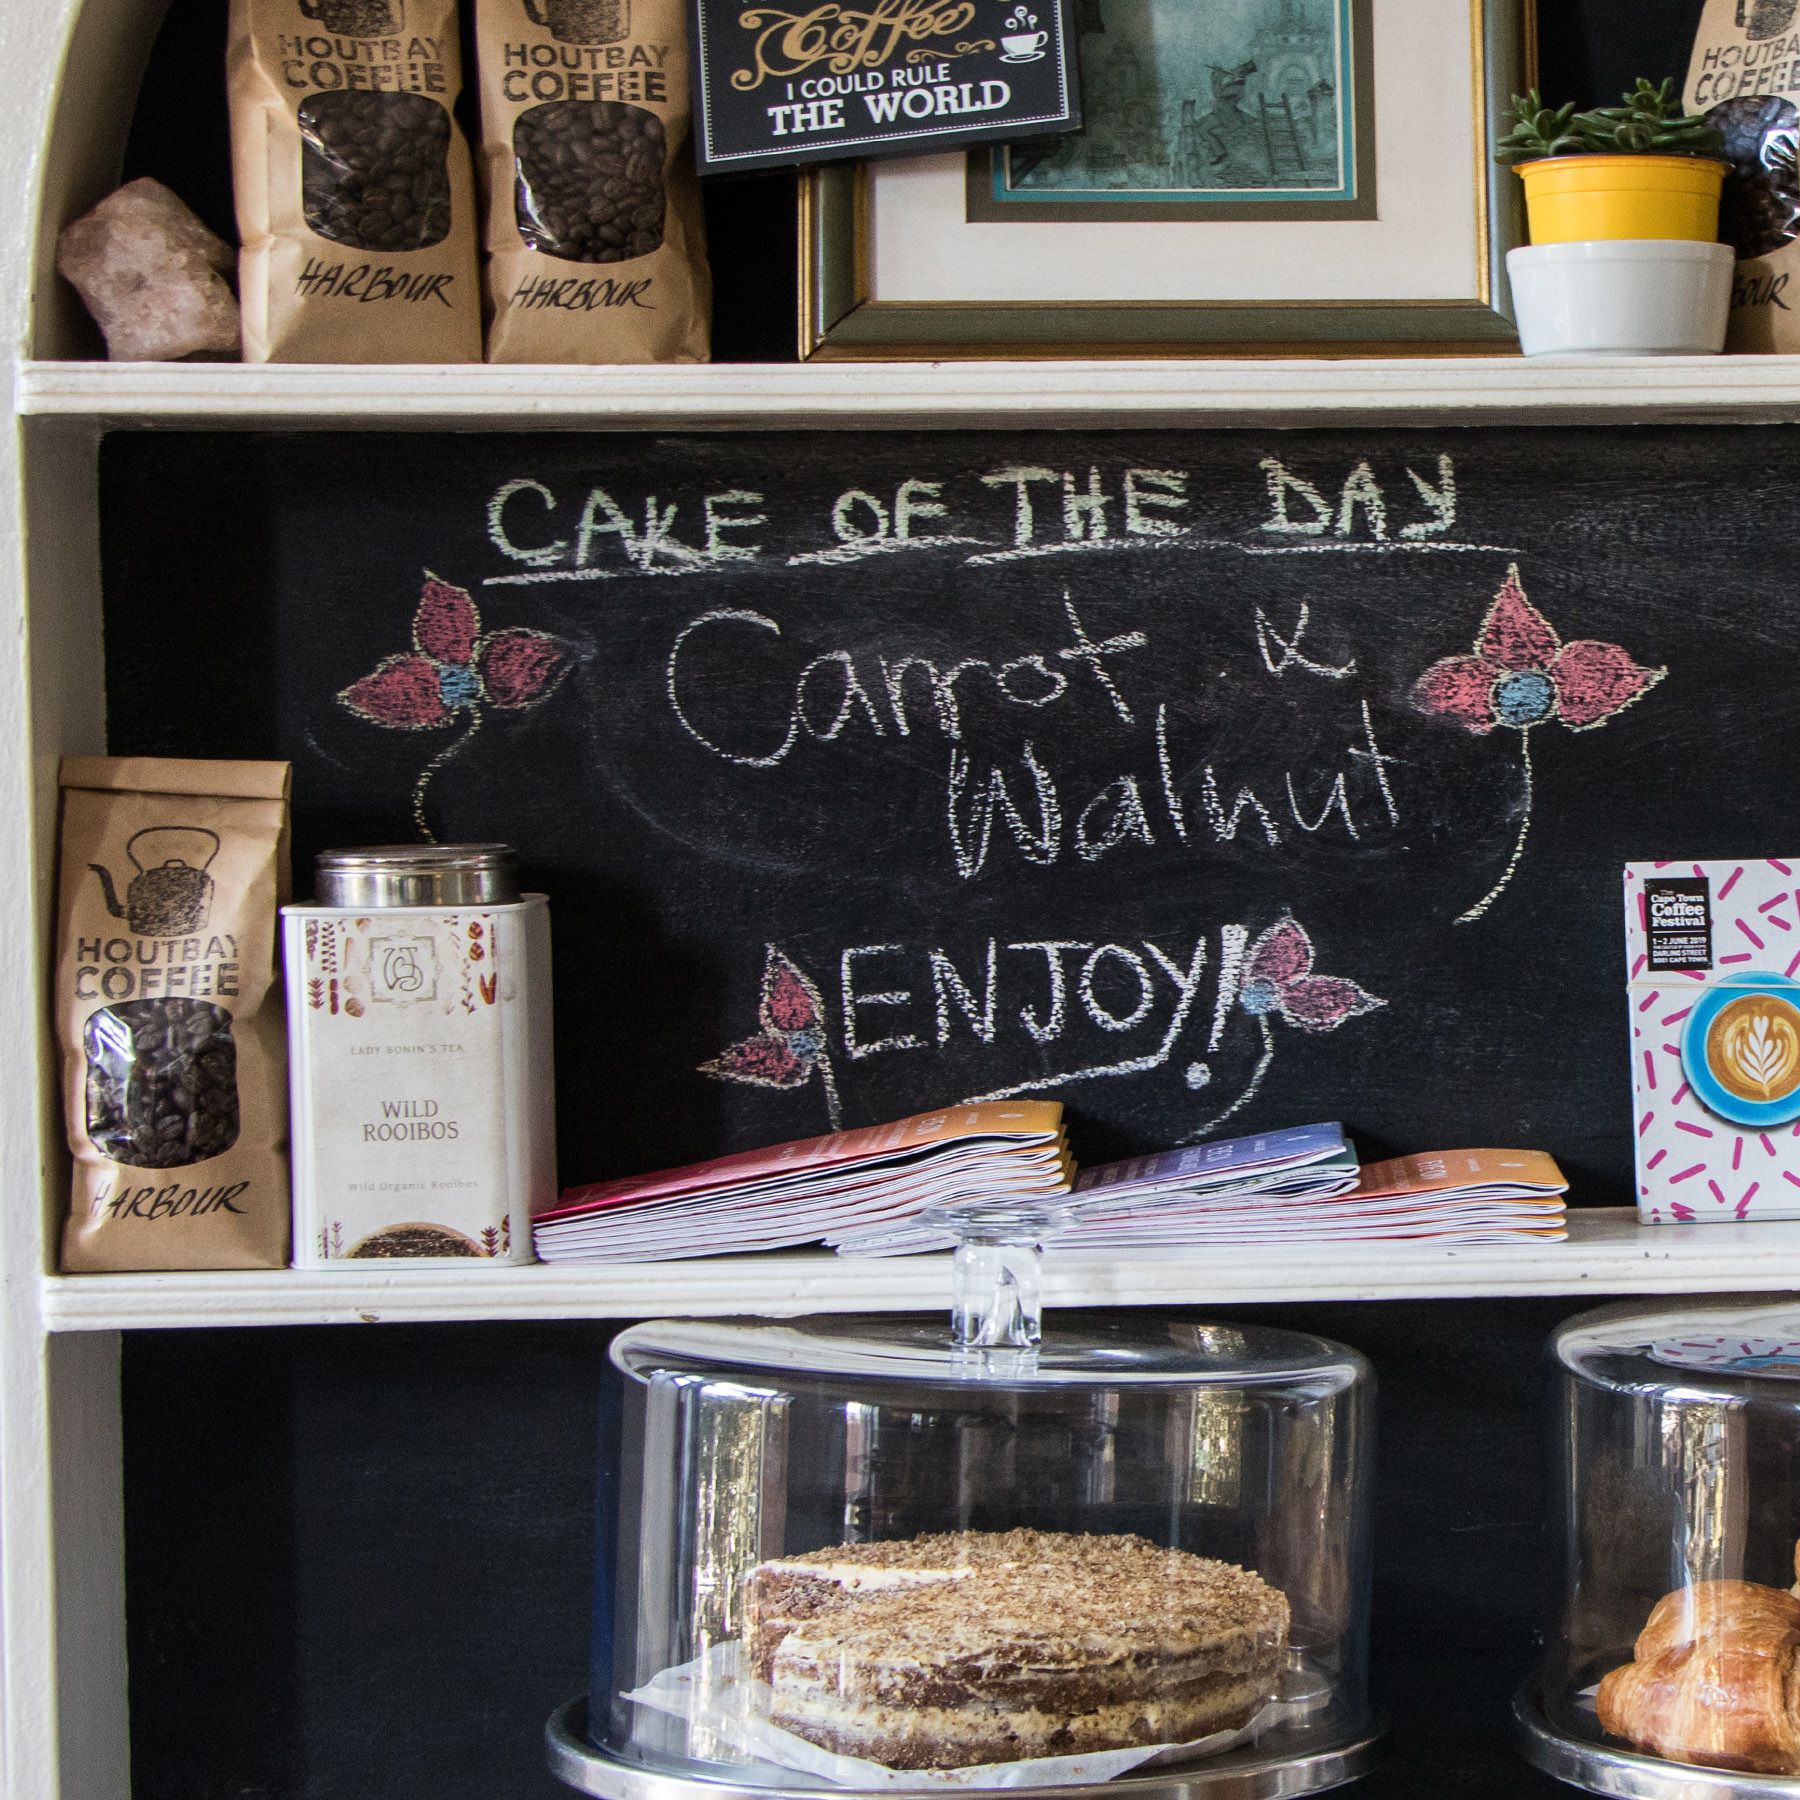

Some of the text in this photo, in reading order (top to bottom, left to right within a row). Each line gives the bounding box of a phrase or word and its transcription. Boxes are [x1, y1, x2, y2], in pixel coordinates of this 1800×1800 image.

[279, 34, 445, 62] HOUTBAY
[504, 43, 670, 70] HOUTBAY
[731, 0, 976, 90] Coffee
[283, 60, 448, 93] COFFEE
[503, 70, 668, 103] COFFEE
[786, 63, 951, 100] I COULD RULE
[767, 80, 1011, 136] THE WORLD
[297, 256, 454, 308] HARBOUR
[509, 275, 658, 310] HARBOUR
[485, 452, 1457, 572] CAKE OF THE DAY
[668, 590, 1148, 768] Carrot
[949, 699, 1402, 880] Walnut
[1651, 895, 1676, 903] Cape
[1651, 903, 1705, 916] Coffee
[1652, 917, 1705, 926] Festival
[77, 935, 239, 965] HOUTBAY
[75, 963, 240, 1001] COFFEE
[841, 923, 1250, 1100] ENJOY!
[350, 1046, 381, 1055] LADY
[440, 1043, 464, 1053] TEA
[382, 1100, 439, 1118] WILD
[363, 1121, 460, 1142] ROOIBOS
[90, 1180, 250, 1220] HARBOUR
[379, 1181, 426, 1193] Organic
